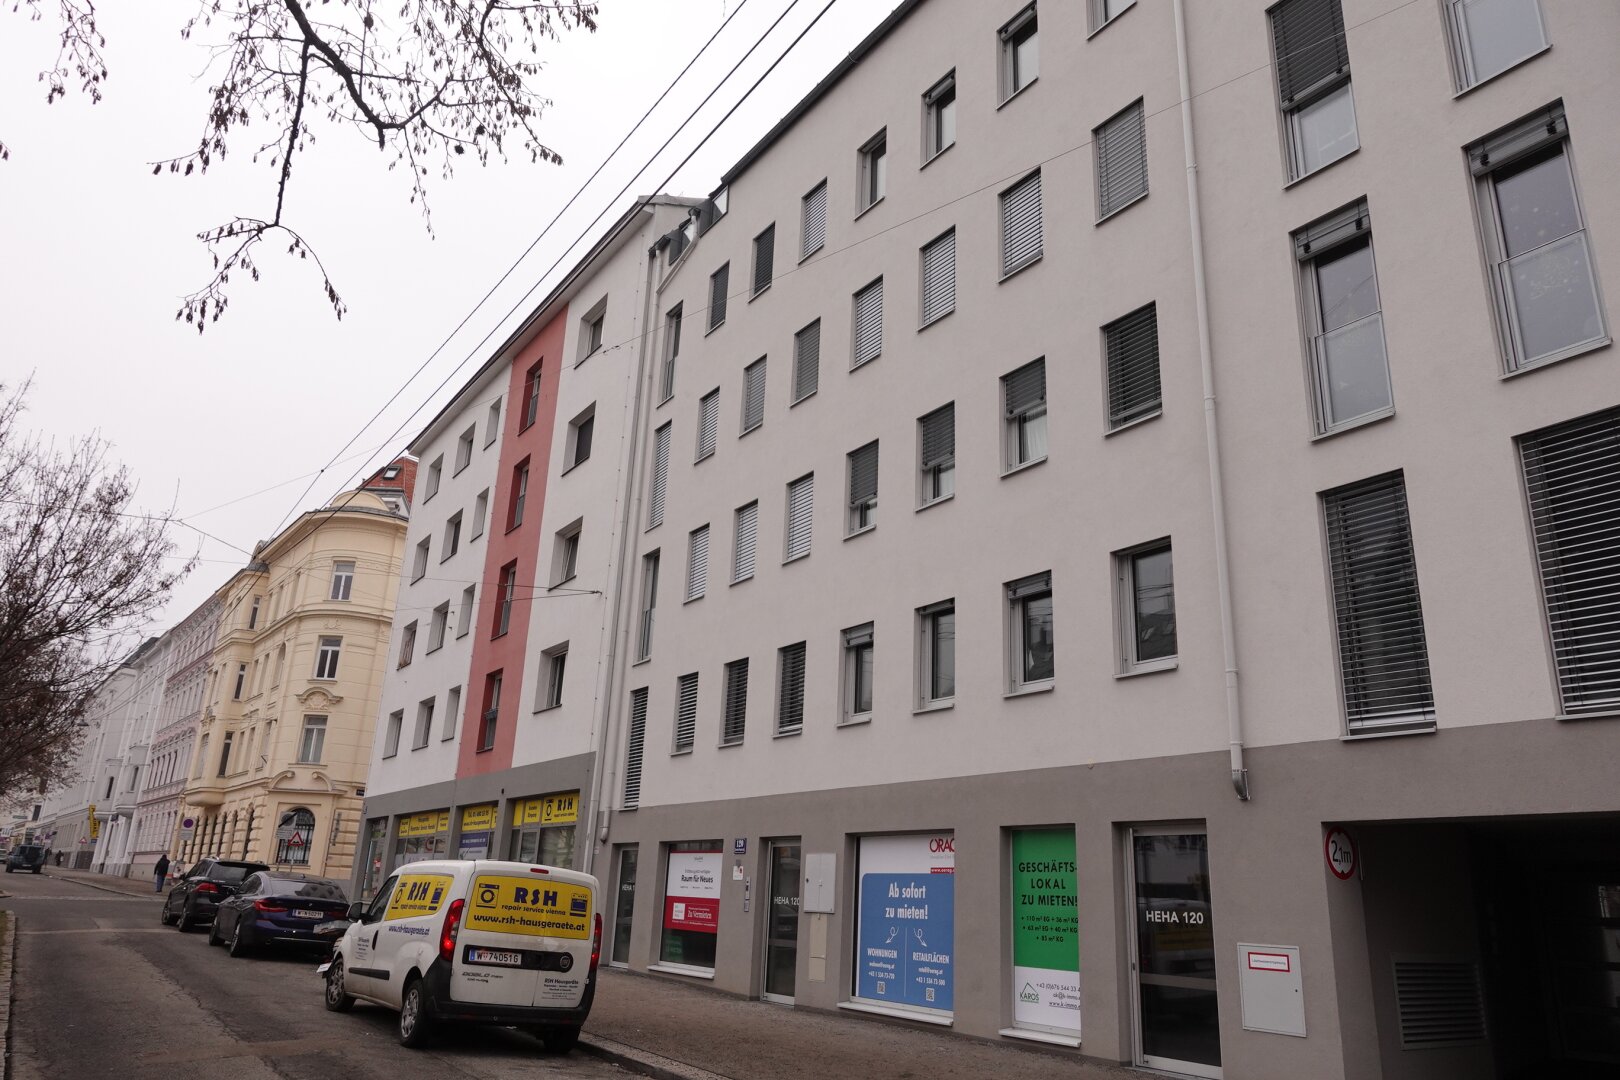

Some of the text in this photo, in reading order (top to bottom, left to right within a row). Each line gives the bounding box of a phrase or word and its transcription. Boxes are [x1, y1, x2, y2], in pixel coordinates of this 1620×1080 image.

[558, 798, 574, 811] RSH
[1018, 860, 1077, 873] GESCHÄFTS-
[888, 882, 926, 899] Ab sofort
[1031, 879, 1066, 889] LOKAL
[408, 882, 430, 902] RSH
[514, 886, 558, 907] RSH
[774, 896, 789, 904] HEHA
[1022, 895, 1078, 906] ZU MIETEN!
[501, 904, 522, 912] repair
[523, 906, 544, 914] service
[885, 904, 928, 920] zu mieten!
[474, 914, 585, 932] www.rsh-hausgeraete.at
[1146, 910, 1204, 924] HEHA 120
[867, 948, 898, 959] WOHNUNGEN
[913, 952, 950, 964] RETAILFLÄCHEN
[1020, 992, 1039, 1001] KAROS
